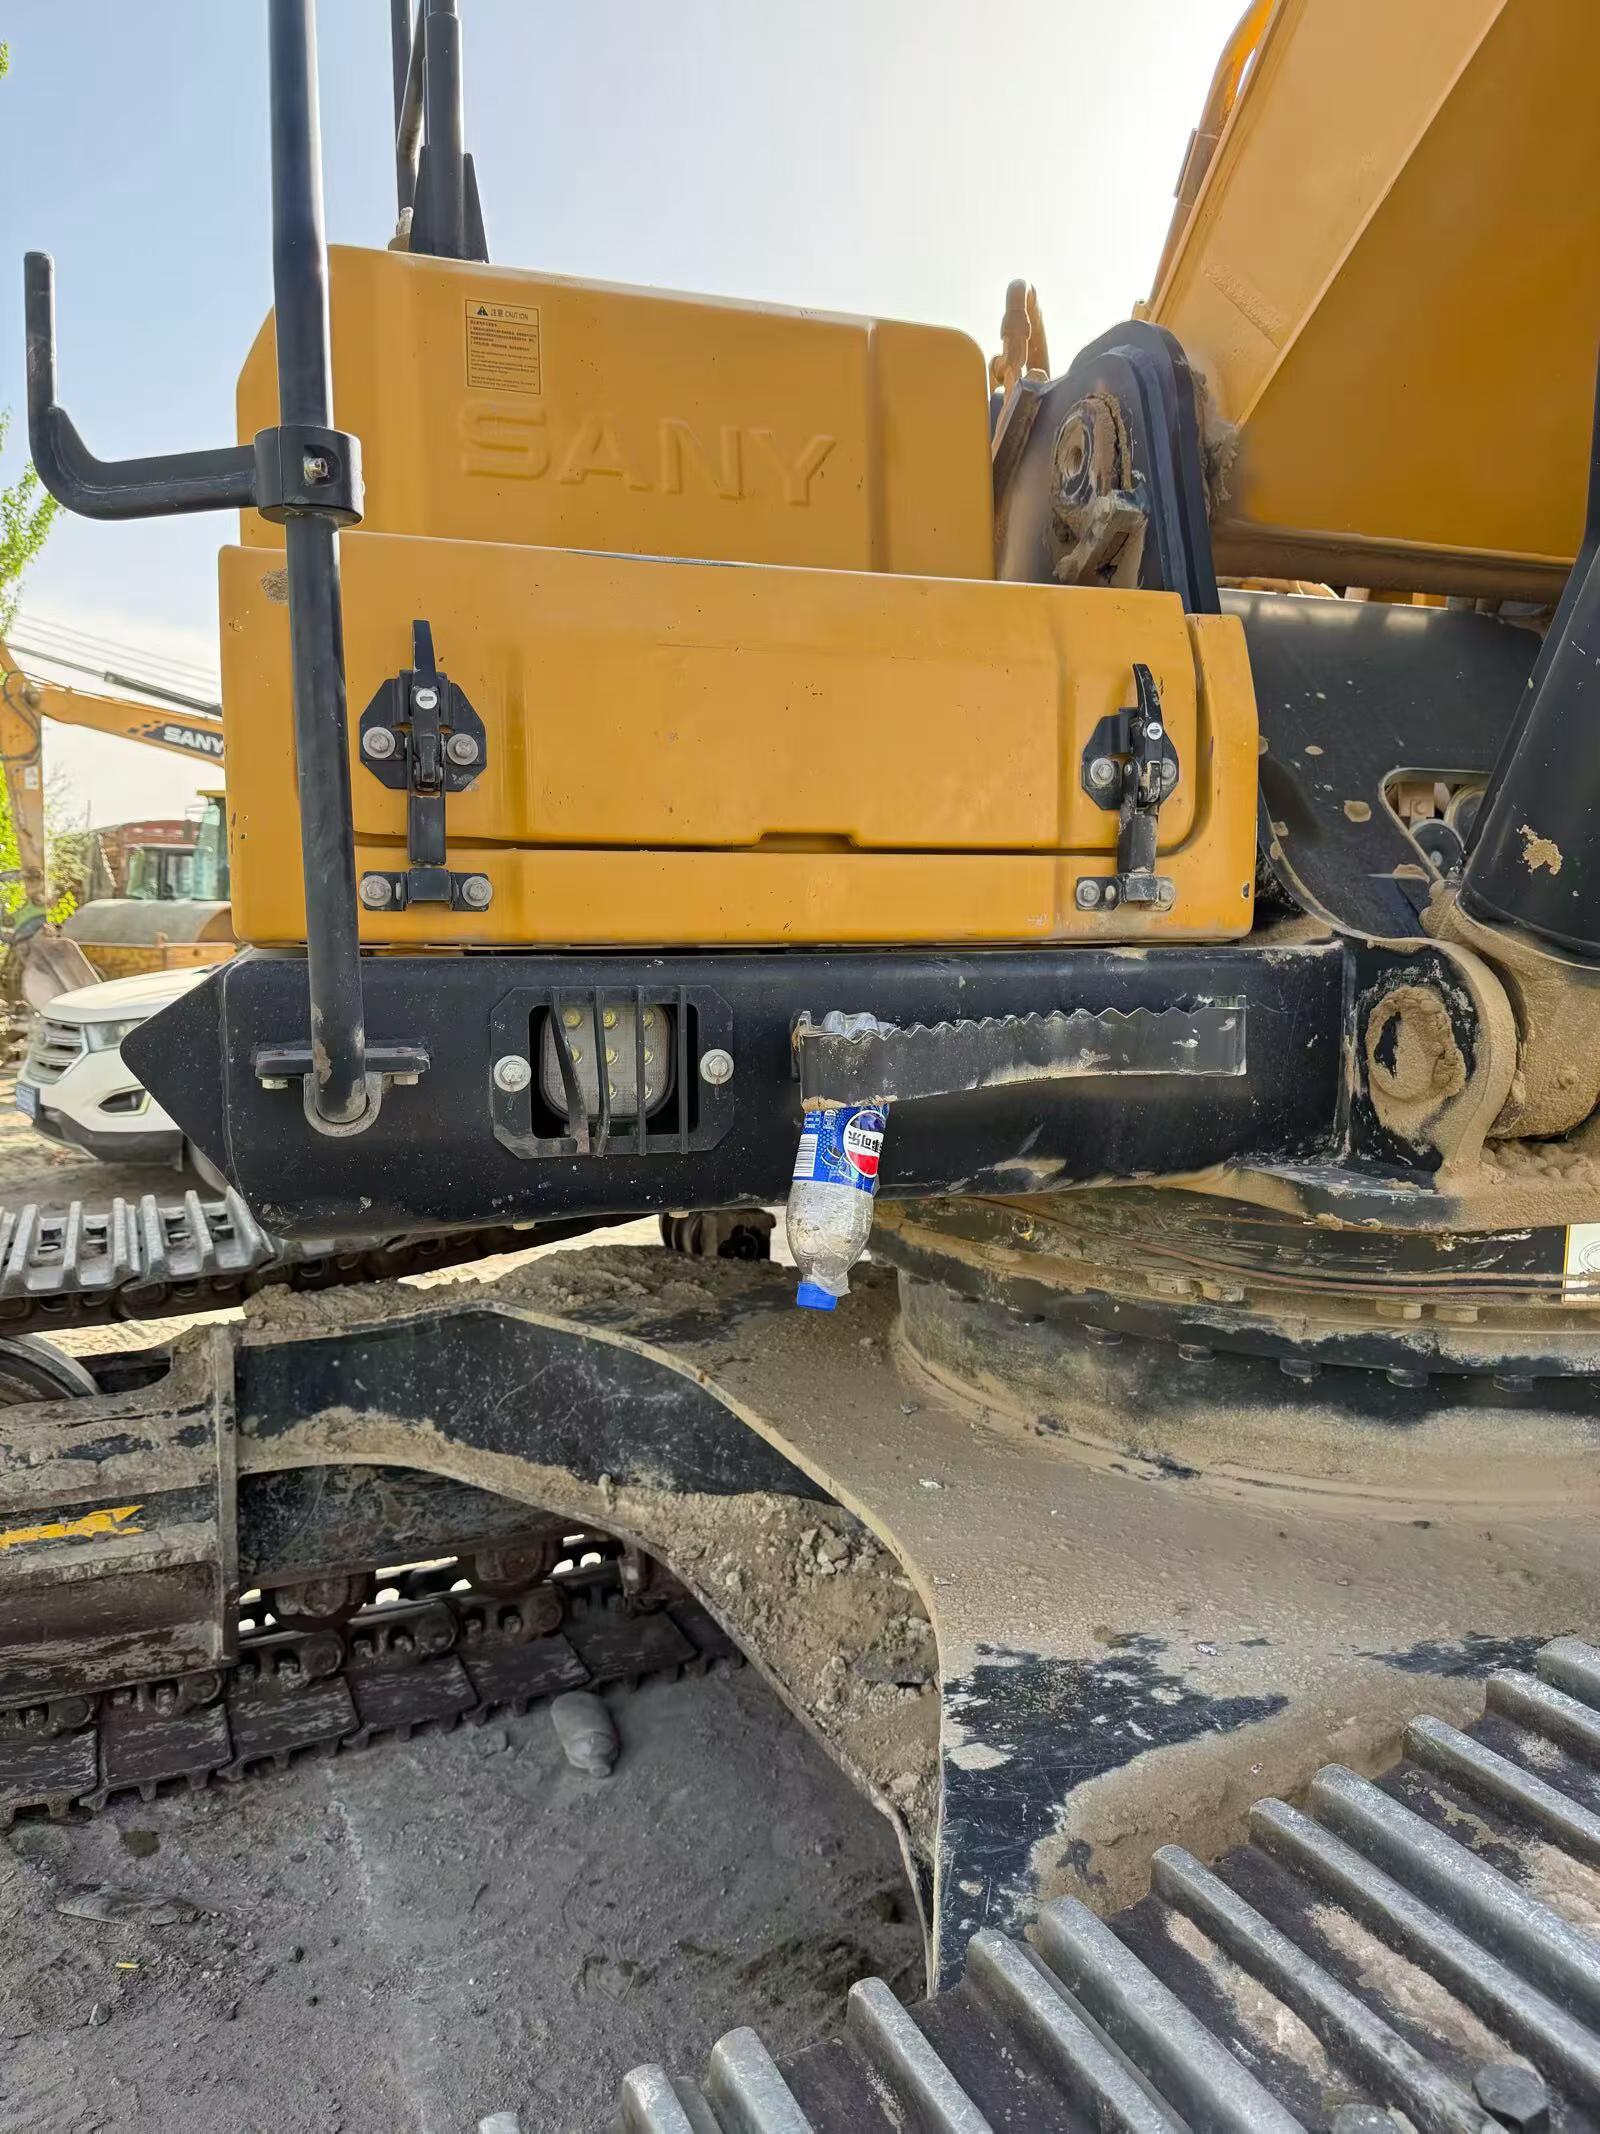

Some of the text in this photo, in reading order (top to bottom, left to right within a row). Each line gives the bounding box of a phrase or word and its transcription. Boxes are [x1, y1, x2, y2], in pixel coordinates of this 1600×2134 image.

[460, 399, 837, 506] SANY
[164, 726, 224, 753] SANY
[848, 1130, 883, 1154] 事可乐
